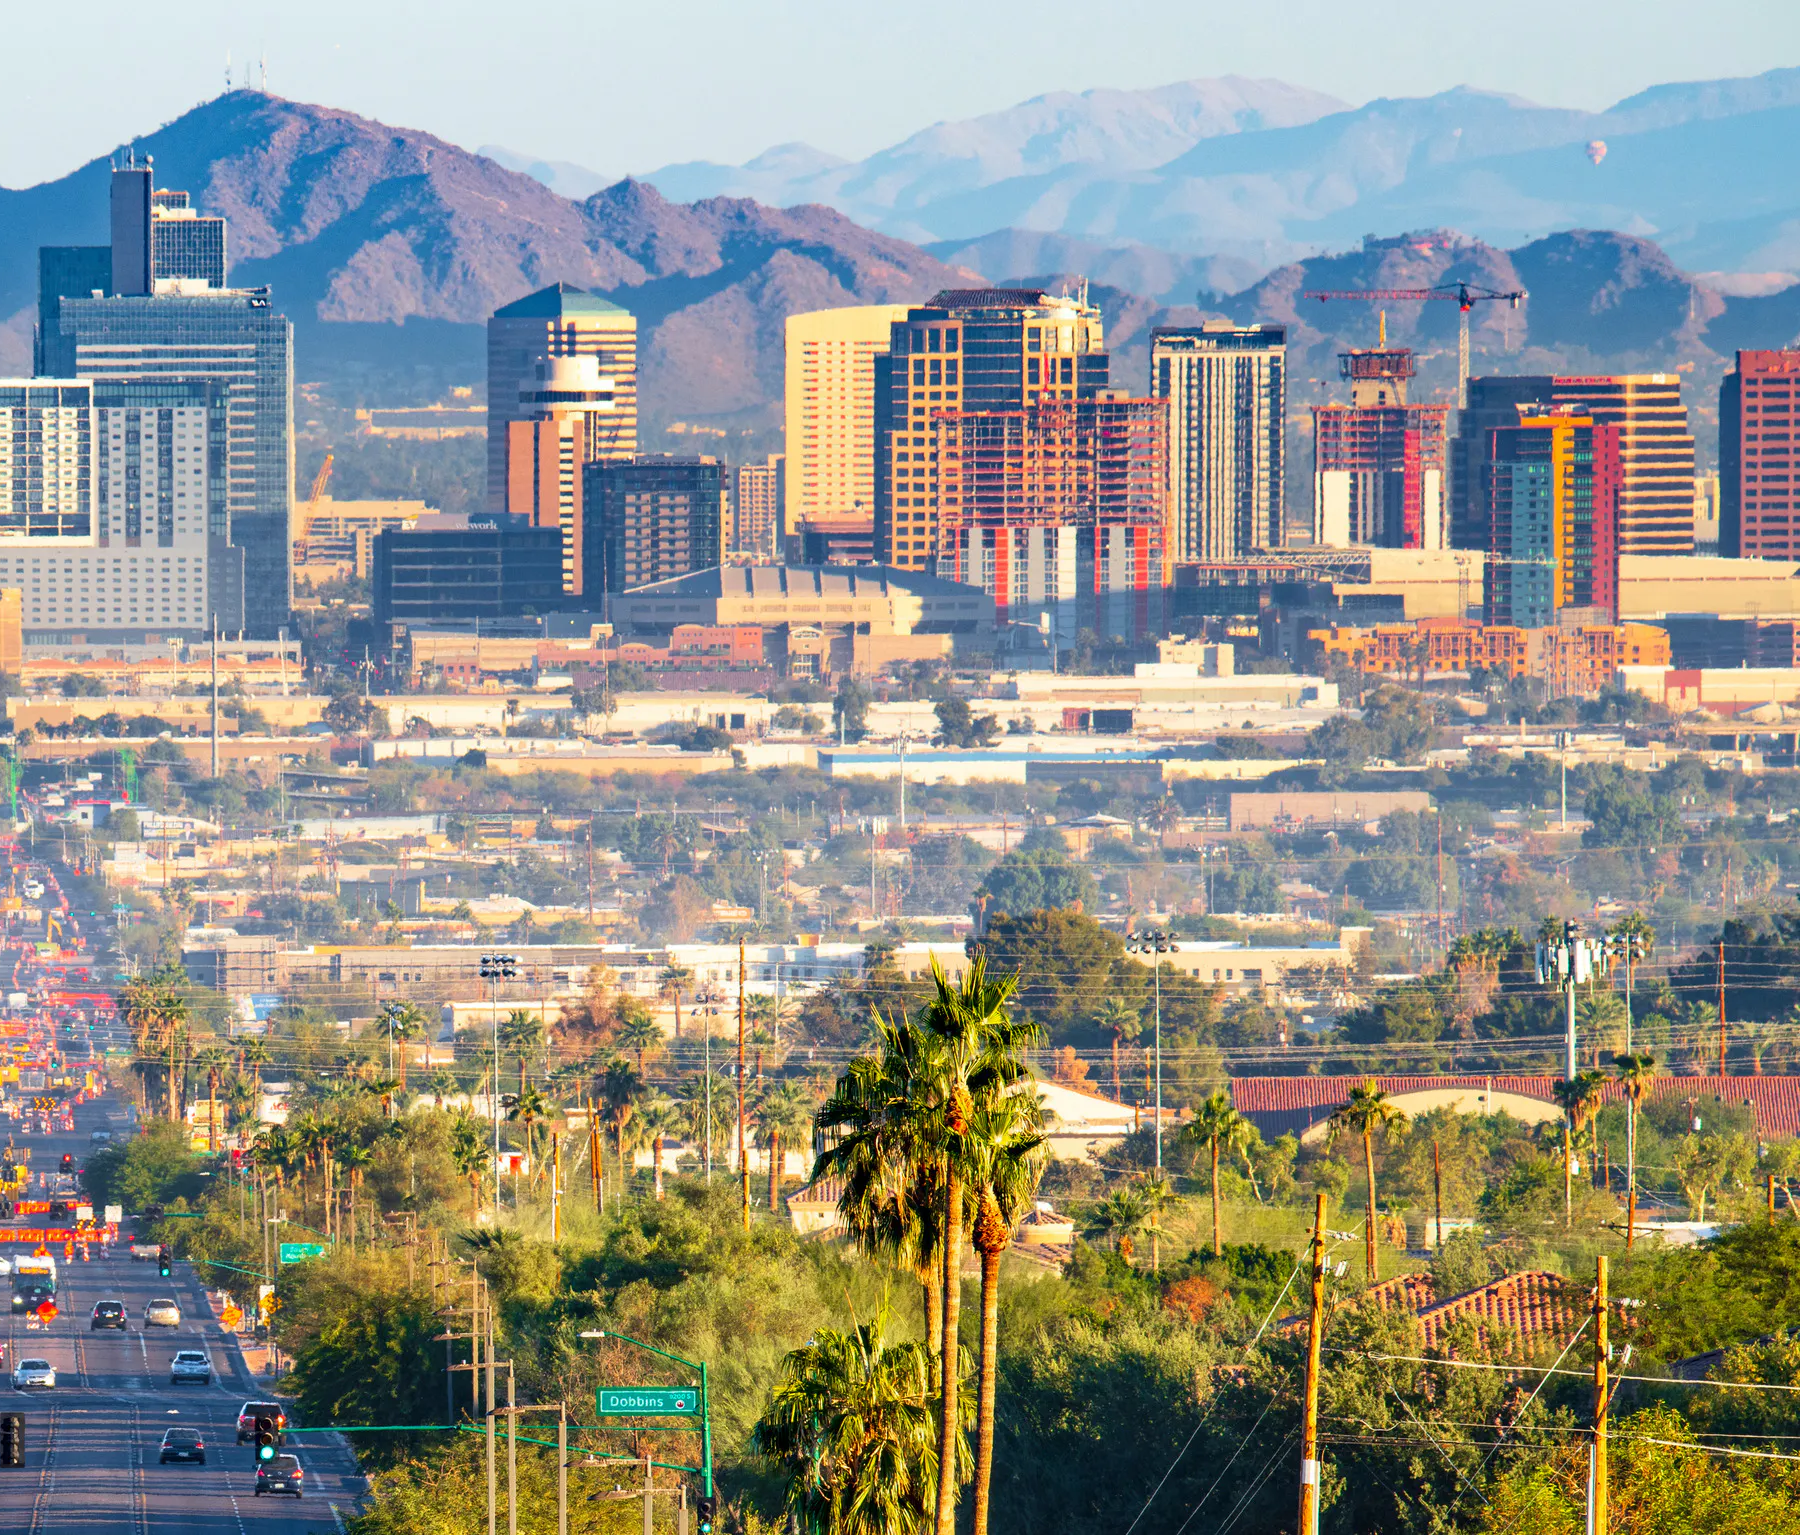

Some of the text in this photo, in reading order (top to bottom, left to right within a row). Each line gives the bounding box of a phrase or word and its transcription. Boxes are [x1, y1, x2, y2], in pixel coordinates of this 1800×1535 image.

[401, 520, 418, 530] EY
[455, 519, 498, 530] wework
[610, 1396, 664, 1407] Dobbins
